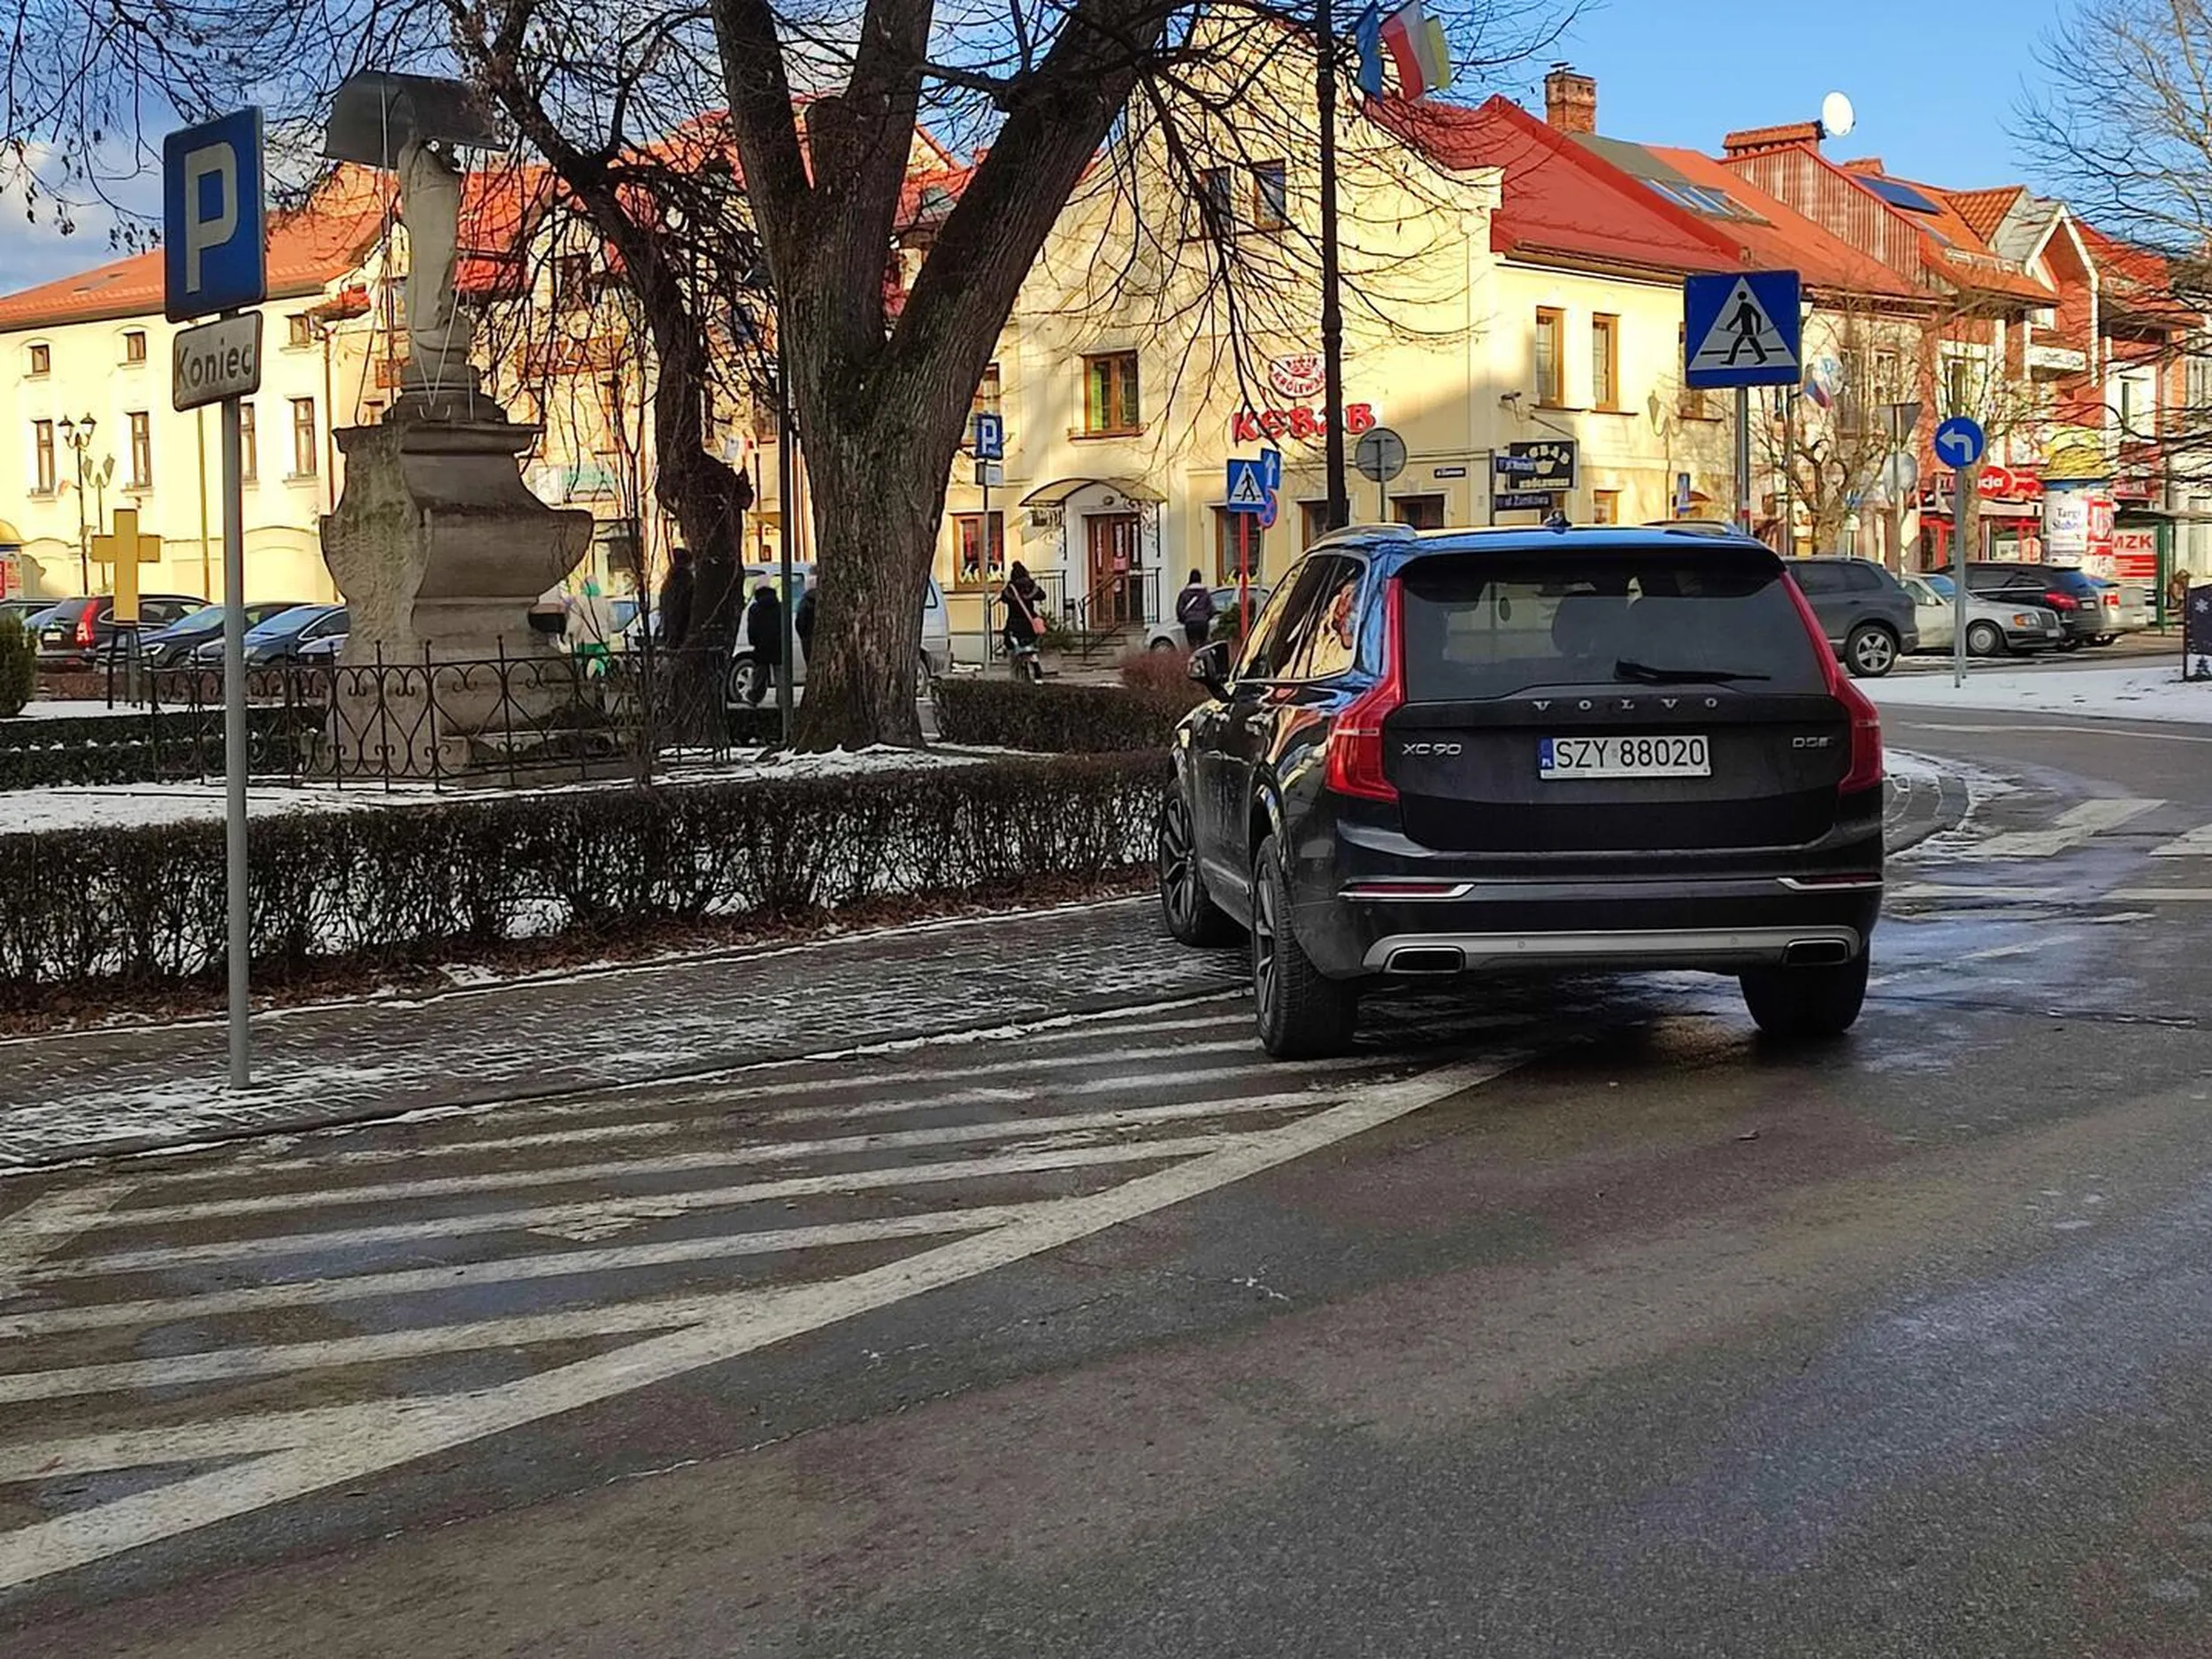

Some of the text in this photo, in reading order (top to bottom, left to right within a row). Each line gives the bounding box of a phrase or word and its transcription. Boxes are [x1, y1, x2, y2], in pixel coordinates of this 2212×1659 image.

[185, 142, 238, 294] P
[176, 337, 253, 389] Koniec
[981, 419, 998, 454] P
[1532, 697, 1717, 711] VOLVO
[1402, 743, 1462, 756] XC90
[1555, 740, 1609, 768] SZY
[1619, 738, 1705, 767] 88020
